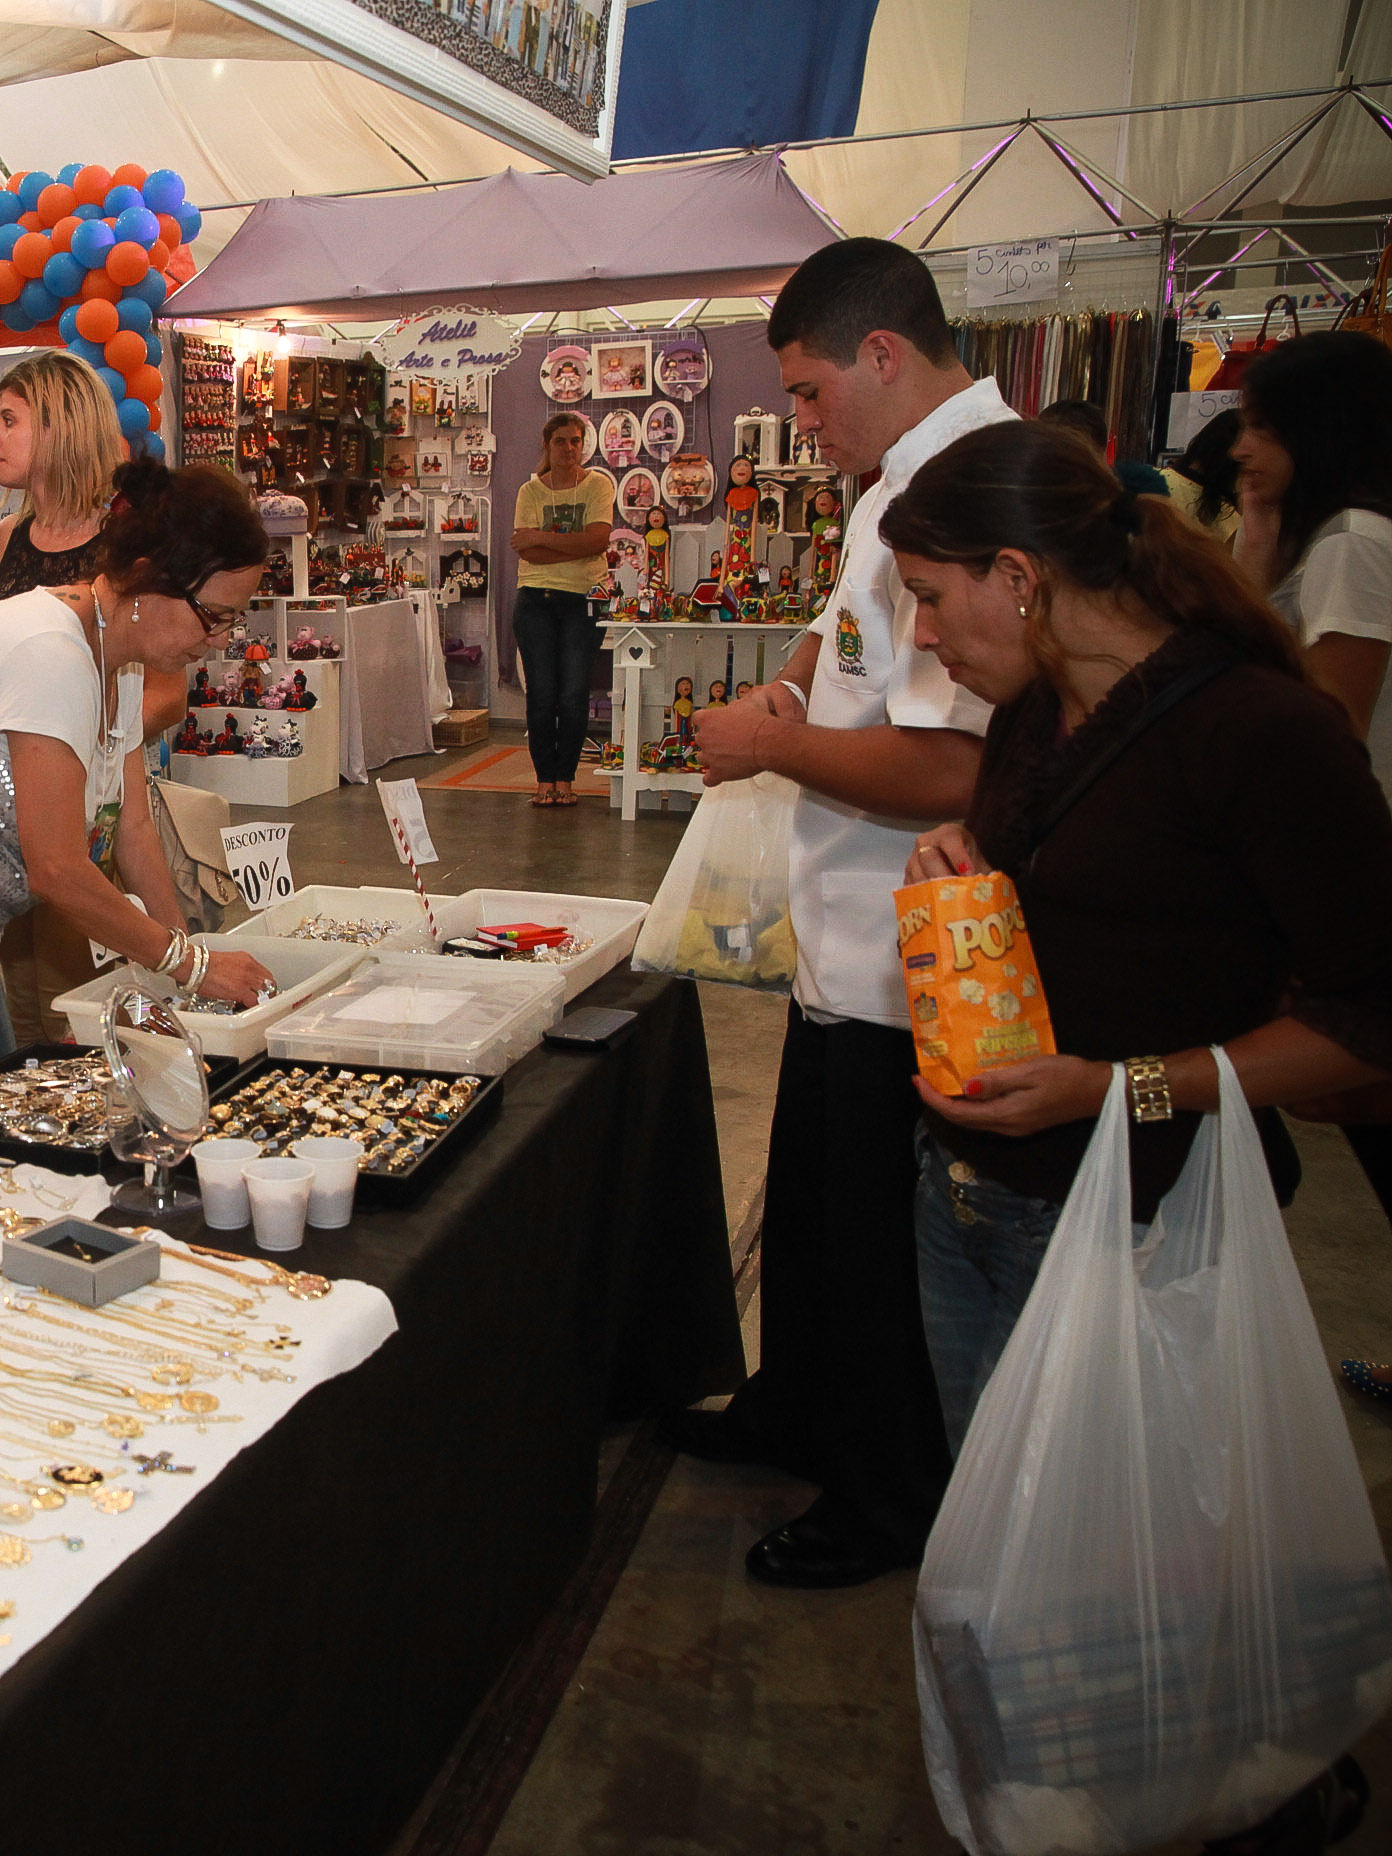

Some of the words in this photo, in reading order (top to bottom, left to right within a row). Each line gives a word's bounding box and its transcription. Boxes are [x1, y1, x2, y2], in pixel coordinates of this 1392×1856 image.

[976, 248, 994, 275] 5
[396, 350, 434, 369] Arte
[440, 358, 451, 368] e
[456, 348, 505, 368] Prosa
[1198, 392, 1218, 418] 5
[224, 827, 287, 852] DESCONTO
[895, 904, 931, 947] ORN
